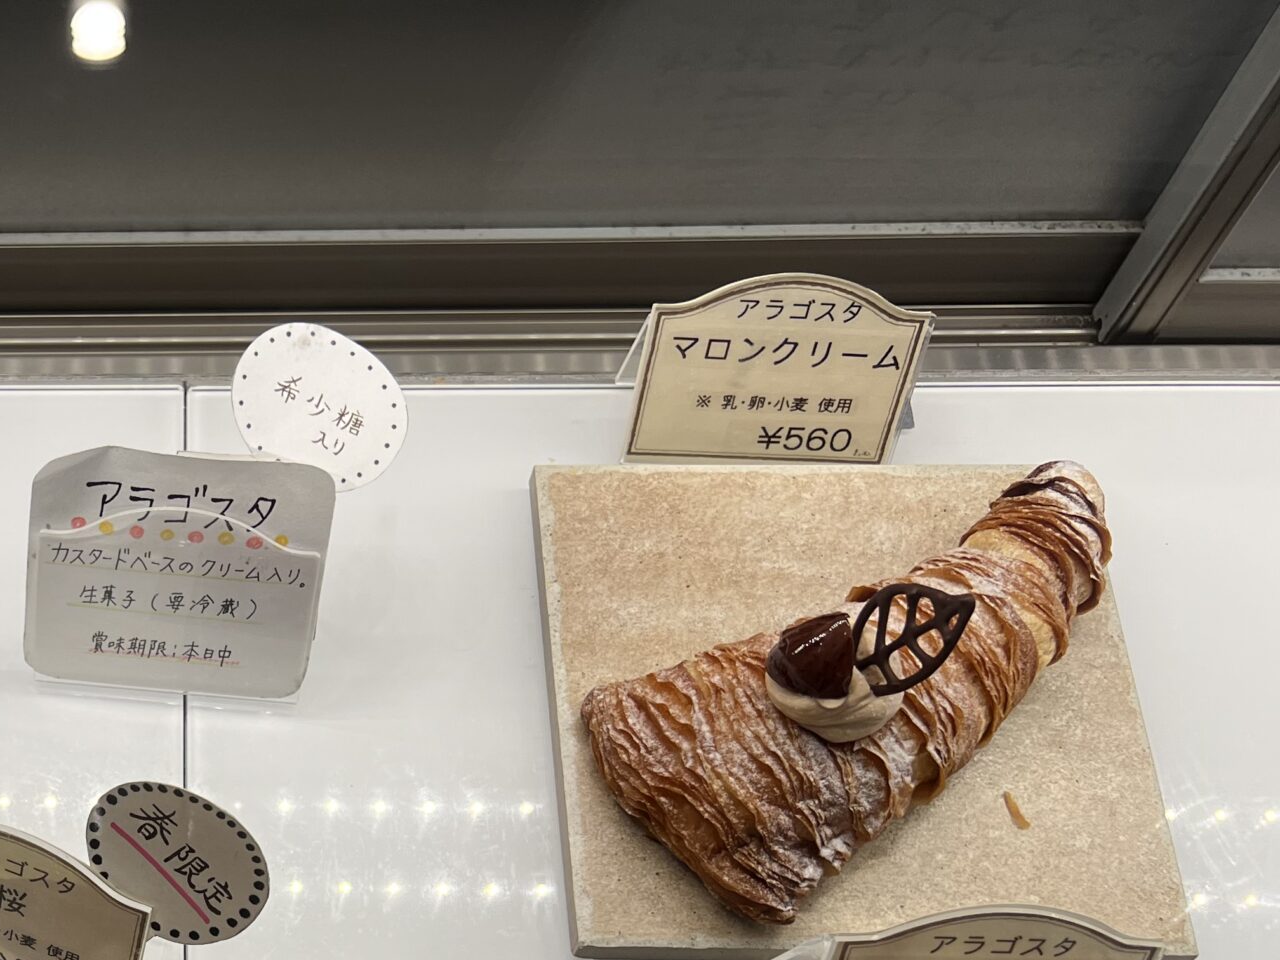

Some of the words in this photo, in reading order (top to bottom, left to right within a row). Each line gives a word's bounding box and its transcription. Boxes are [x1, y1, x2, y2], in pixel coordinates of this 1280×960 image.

[736, 299, 863, 324] アラゴスタ
[672, 336, 901, 370] マロンクリーム
[273, 375, 366, 438] 希少糖
[817, 396, 853, 414] 使用
[311, 430, 346, 456] 入り
[757, 426, 853, 452] ¥560
[85, 480, 277, 533] アラゴスタ
[129, 802, 234, 916] 春限定
[929, 935, 1078, 957] アラゴスタ
